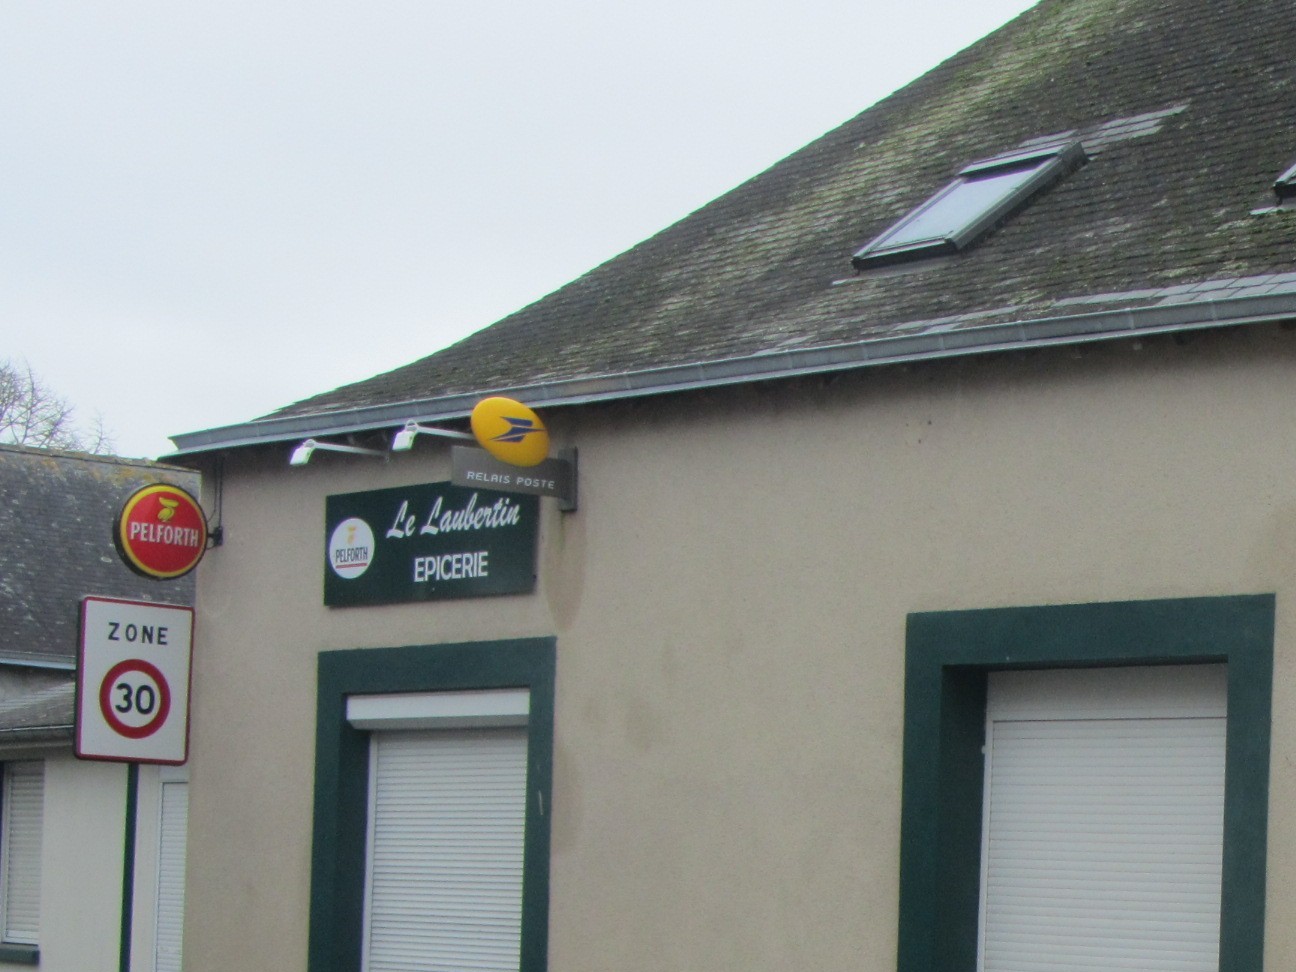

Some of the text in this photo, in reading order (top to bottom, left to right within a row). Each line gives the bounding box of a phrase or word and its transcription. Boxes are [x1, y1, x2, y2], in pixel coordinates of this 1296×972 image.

[466, 470, 556, 490] RELAIS POSTE
[386, 493, 521, 539] Le Laubertin
[130, 521, 200, 549] PELFORTH
[335, 547, 368, 563] PELFORTH
[414, 551, 489, 583] EPICERIE
[107, 621, 169, 646] ZONE
[114, 682, 156, 716] 30
